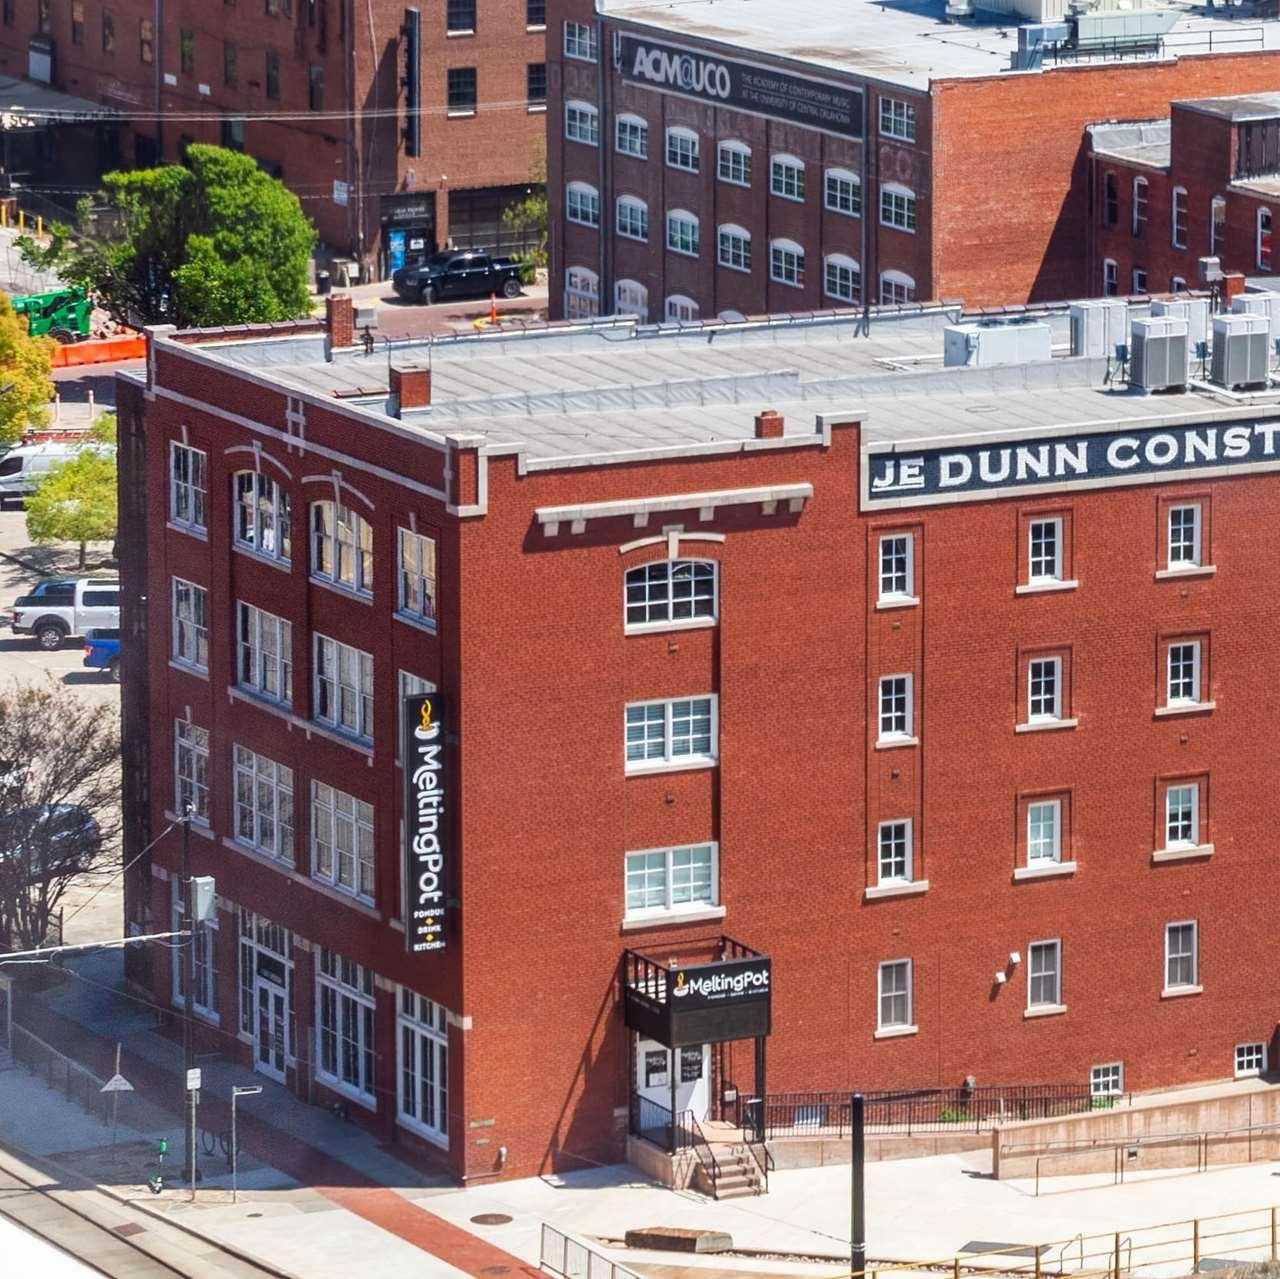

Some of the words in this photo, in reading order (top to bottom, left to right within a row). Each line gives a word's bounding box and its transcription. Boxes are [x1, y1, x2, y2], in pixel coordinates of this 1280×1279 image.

[632, 46, 731, 99] ACM@UCO
[871, 457, 925, 492] JE
[938, 441, 1089, 488] DUNN
[412, 743, 444, 904] MeltingPot
[689, 970, 769, 995] MeltingPot
